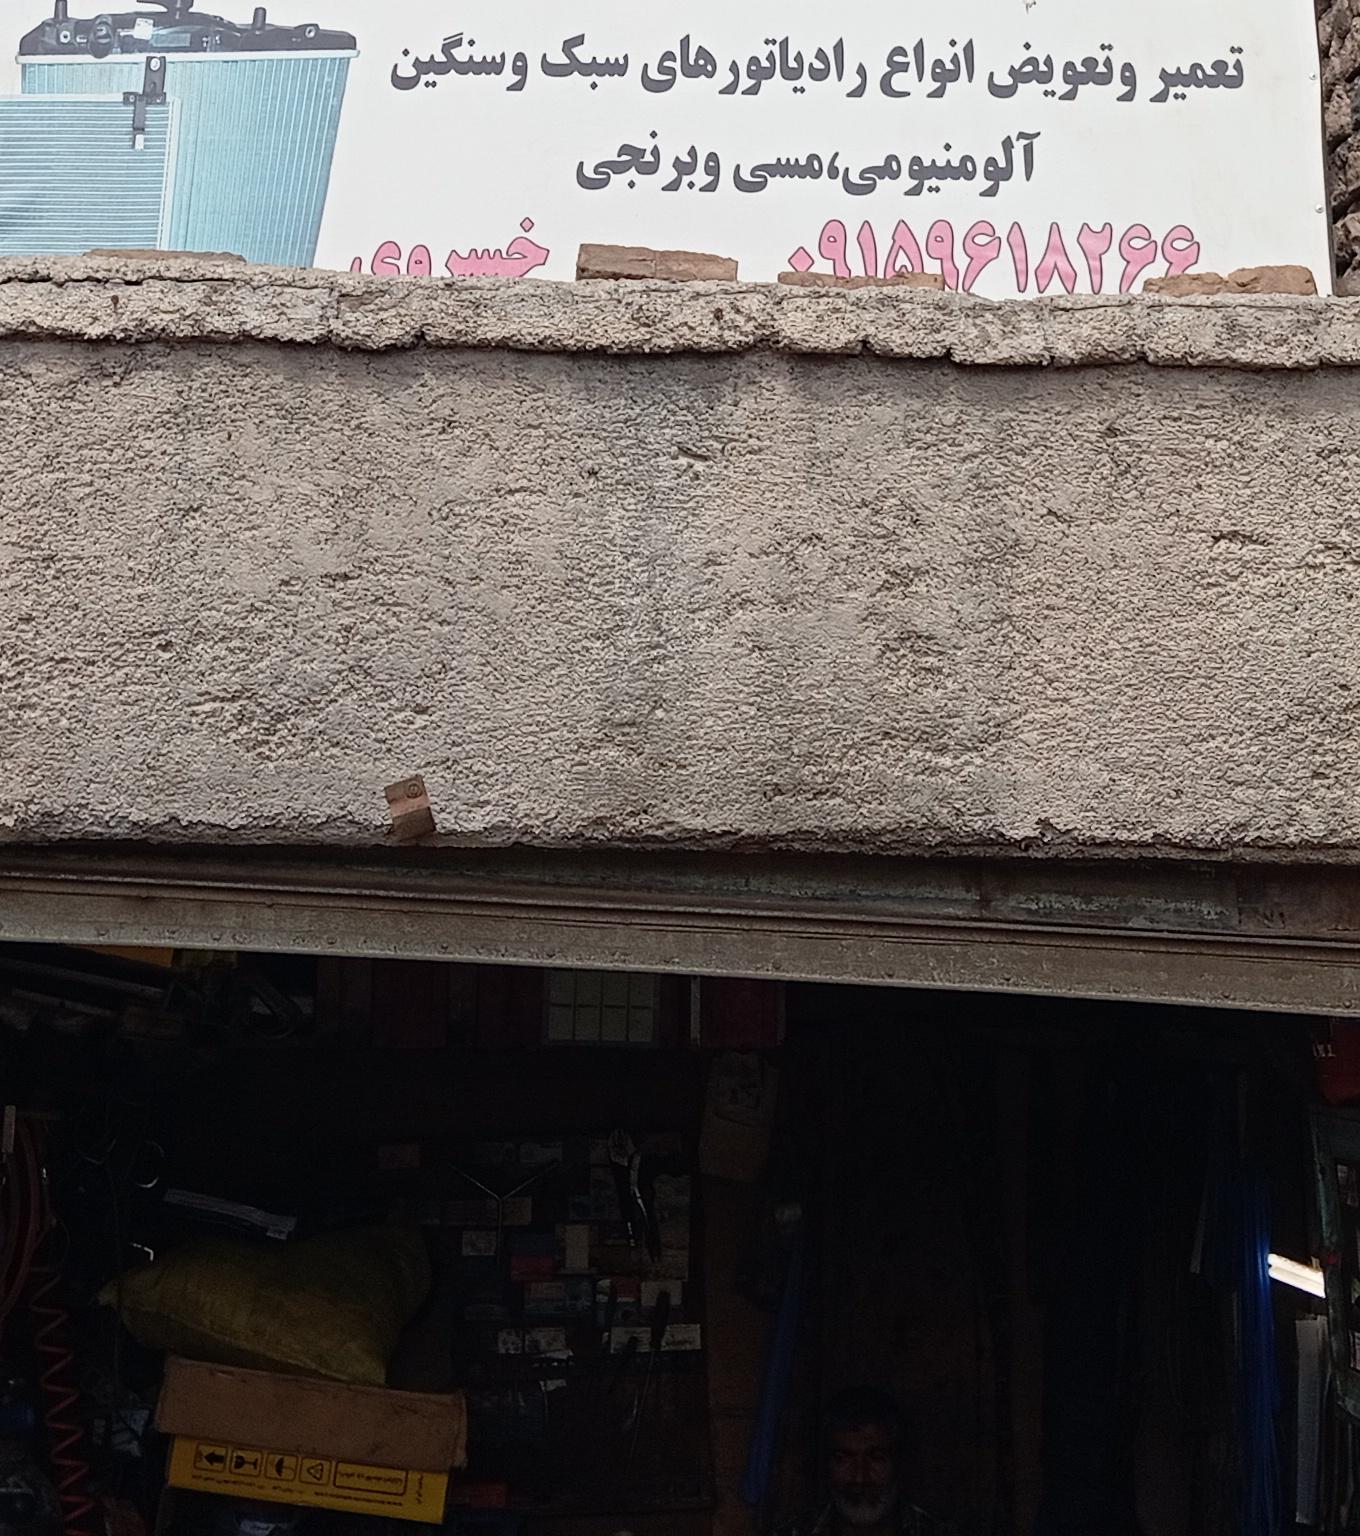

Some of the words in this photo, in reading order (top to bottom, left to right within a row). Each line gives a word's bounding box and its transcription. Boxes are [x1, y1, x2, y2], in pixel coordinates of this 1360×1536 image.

[540, 33, 629, 91] سبک
[640, 34, 868, 99] رادیاتورهای
[879, 37, 975, 99] انواع
[1148, 45, 1245, 104] تعمیر
[787, 219, 1200, 295] ۰۹۱۵۹۶۱۸۲۶۶
